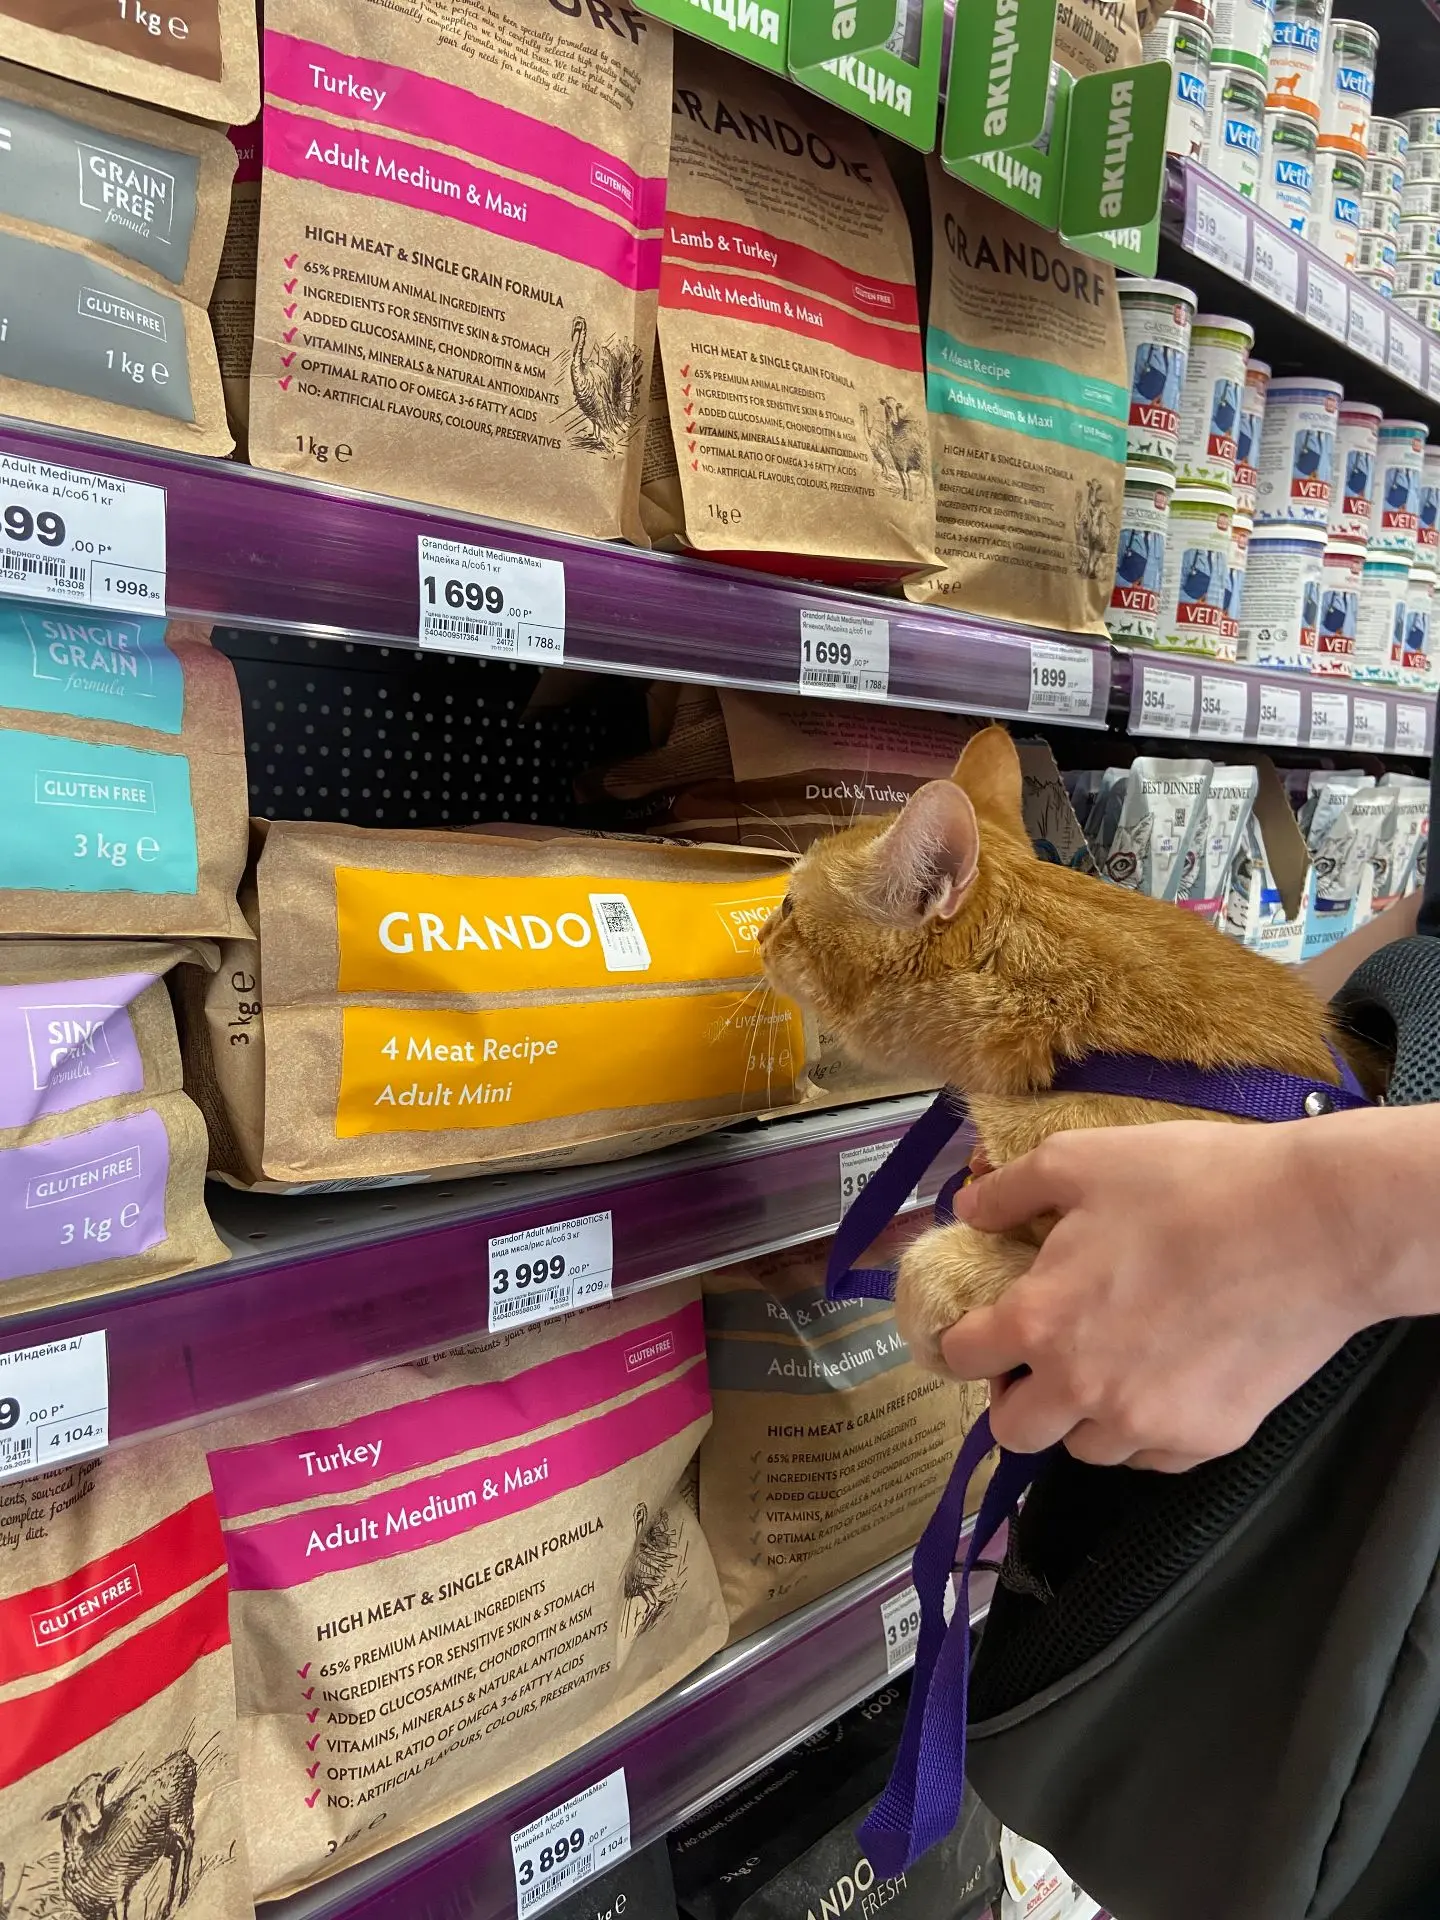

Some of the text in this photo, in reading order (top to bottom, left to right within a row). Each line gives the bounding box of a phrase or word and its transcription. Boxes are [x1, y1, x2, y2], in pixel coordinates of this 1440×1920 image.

[135, 5, 162, 36] kg
[437, 35, 458, 48] your
[462, 44, 475, 58] dog
[478, 52, 499, 64] needs
[500, 61, 513, 72] for
[524, 73, 550, 91] healthy
[309, 64, 386, 110] Turkey
[1099, 80, 1134, 218] акция
[88, 156, 166, 204] GRAIN
[305, 139, 527, 222] Adult Medium & Maxi
[595, 171, 622, 190] GLUTEN
[102, 187, 155, 223] FREE
[104, 207, 151, 239] formula
[670, 228, 778, 267] Lamb & Turkey
[944, 213, 1105, 307] GRANDORF
[305, 226, 564, 309] HIGH MEAT & SINGLE GRAIN FORMULA
[86, 297, 161, 334] GLUTEN FREE
[681, 280, 824, 327] Adult Medium & Maxi
[106, 350, 145, 386] 1 kg
[974, 359, 1012, 379] Recipe
[298, 381, 561, 450] NO: ARTIFICIAL FLAVOURS, COLOURS, PRESERVATIVES
[948, 389, 976, 410] Adult
[977, 398, 1016, 422] Medium
[1028, 414, 1053, 428] Maxi
[296, 435, 328, 463] 1 kg
[2, 459, 125, 493] Adult Medium/Maxi
[708, 504, 728, 525] 1 kg
[422, 538, 542, 568] Grandorf Adult Medium&Maxi
[422, 552, 460, 566] Индейка
[462, 561, 486, 571] д/соб
[54, 578, 85, 590] 16308
[424, 576, 504, 614] 1 699
[41, 619, 129, 652] SINGLE
[49, 642, 137, 678] GRAIN
[816, 642, 851, 665] 699
[63, 672, 127, 697] formula
[1042, 668, 1066, 687] 899
[1144, 690, 1164, 709] 354
[1261, 706, 1277, 720] 354
[44, 780, 148, 803] GLUTEN FREE
[806, 781, 853, 800] Duck
[854, 784, 866, 800] &
[1142, 781, 1201, 794] BEST DINNER
[73, 833, 127, 867] 3 kg
[378, 911, 592, 954] GRANDO
[228, 1001, 262, 1046] 3 kg
[381, 1036, 559, 1064] 4 Meat Recipe
[374, 1082, 513, 1107] Adult Mini
[36, 1156, 133, 1198] GLUTEN FREE
[60, 1217, 112, 1246] 3 kg
[491, 1232, 525, 1247] Grandorf
[526, 1228, 544, 1239] Adult
[546, 1225, 561, 1234] Mini
[562, 1214, 603, 1230] PROBIOTICS
[492, 1248, 509, 1258] вида
[510, 1240, 544, 1253] мяса/рис
[546, 1234, 565, 1245] д/соб
[493, 1255, 565, 1294] 3 999
[14, 1343, 66, 1363] Индейка
[628, 1339, 672, 1365] GLUTEN FREE
[767, 1378, 945, 1438] HIGH MEAT & GRAIN FREE FORMULA
[6, 1450, 31, 1462] 24171
[299, 1439, 383, 1477] Turkey
[1, 1481, 96, 1527] complete formula
[305, 1458, 549, 1557] Adult Medium & Maxi
[26, 1527, 48, 1541] diet.
[39, 1576, 132, 1635] GLUTEN FREE
[861, 1687, 900, 1721] FOOD
[514, 1819, 544, 1841] Grandorf
[545, 1808, 562, 1823] Adult
[519, 1859, 533, 1886] 3
[539, 1827, 585, 1873] 899
[861, 1872, 907, 1920] FRESH
